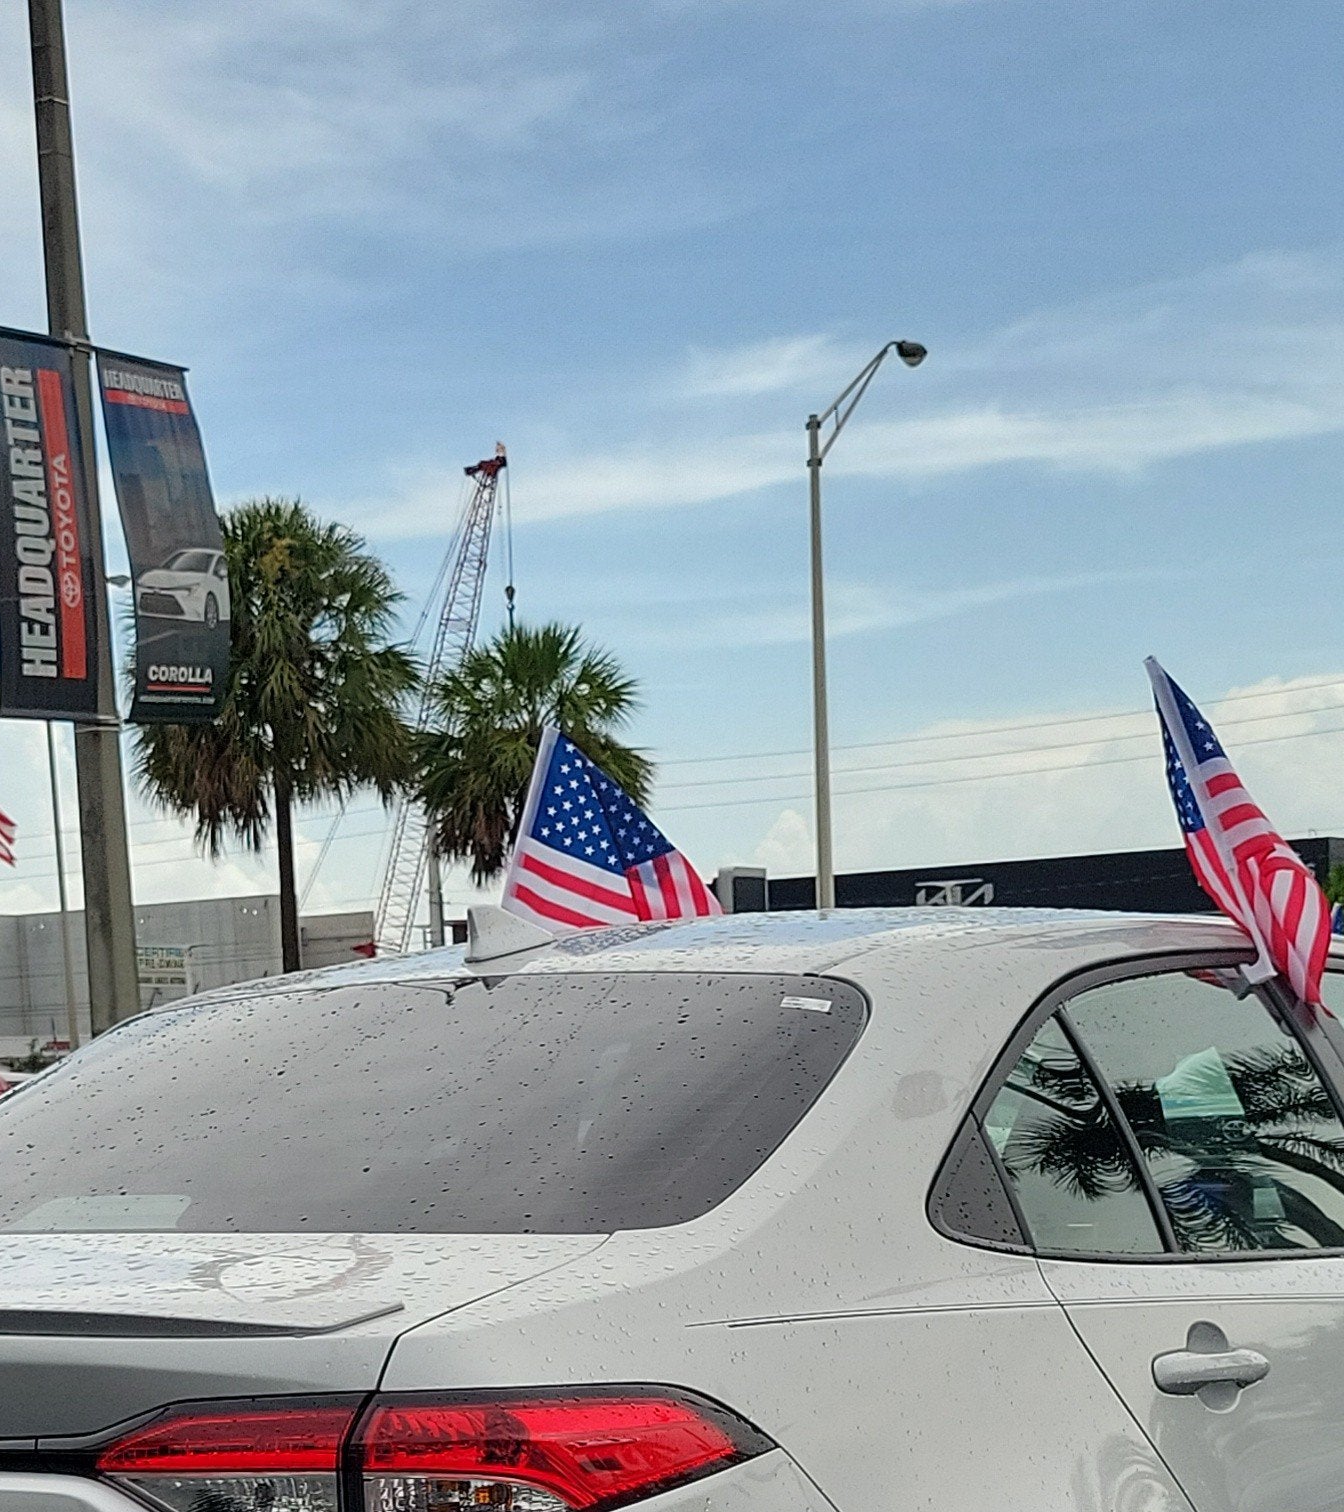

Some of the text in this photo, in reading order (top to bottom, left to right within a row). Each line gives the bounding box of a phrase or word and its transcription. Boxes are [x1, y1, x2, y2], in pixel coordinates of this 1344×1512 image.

[0, 366, 58, 678] HEADQUARTER
[52, 453, 77, 568] TOYOTA
[148, 665, 213, 684] COROLLA
